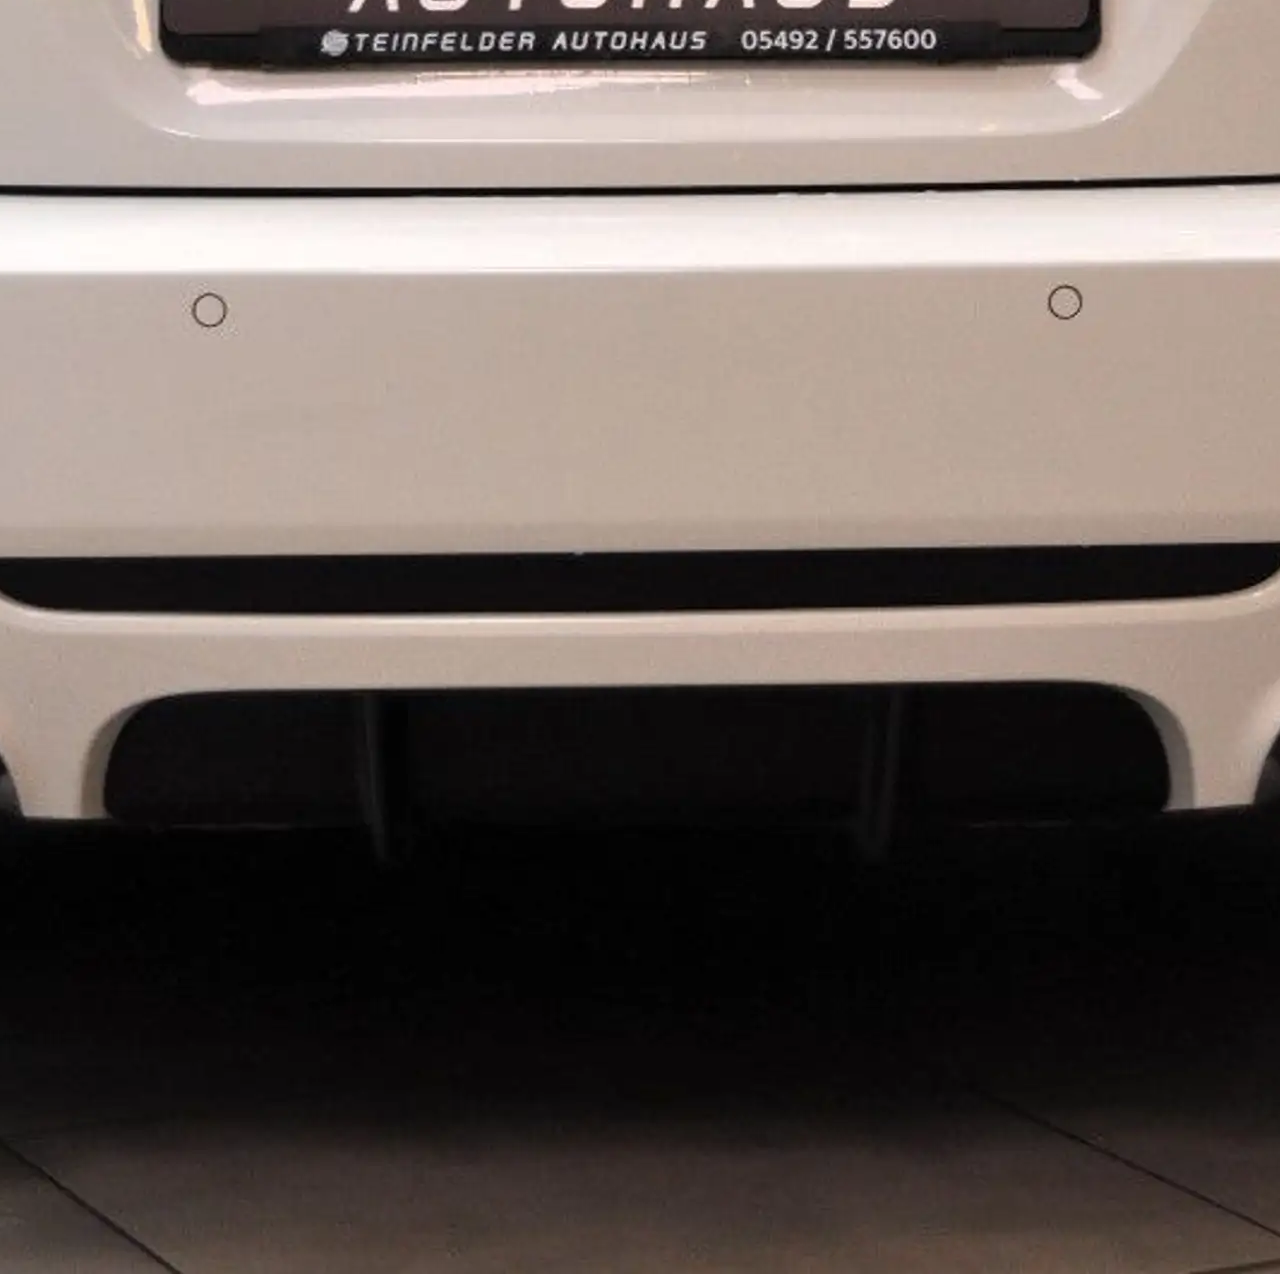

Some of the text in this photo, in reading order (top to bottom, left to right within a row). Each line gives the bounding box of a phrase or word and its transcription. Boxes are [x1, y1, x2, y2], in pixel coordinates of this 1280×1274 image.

[552, 30, 708, 52] AUTOHAUS
[741, 28, 820, 51] 05492
[842, 28, 938, 51] 557600
